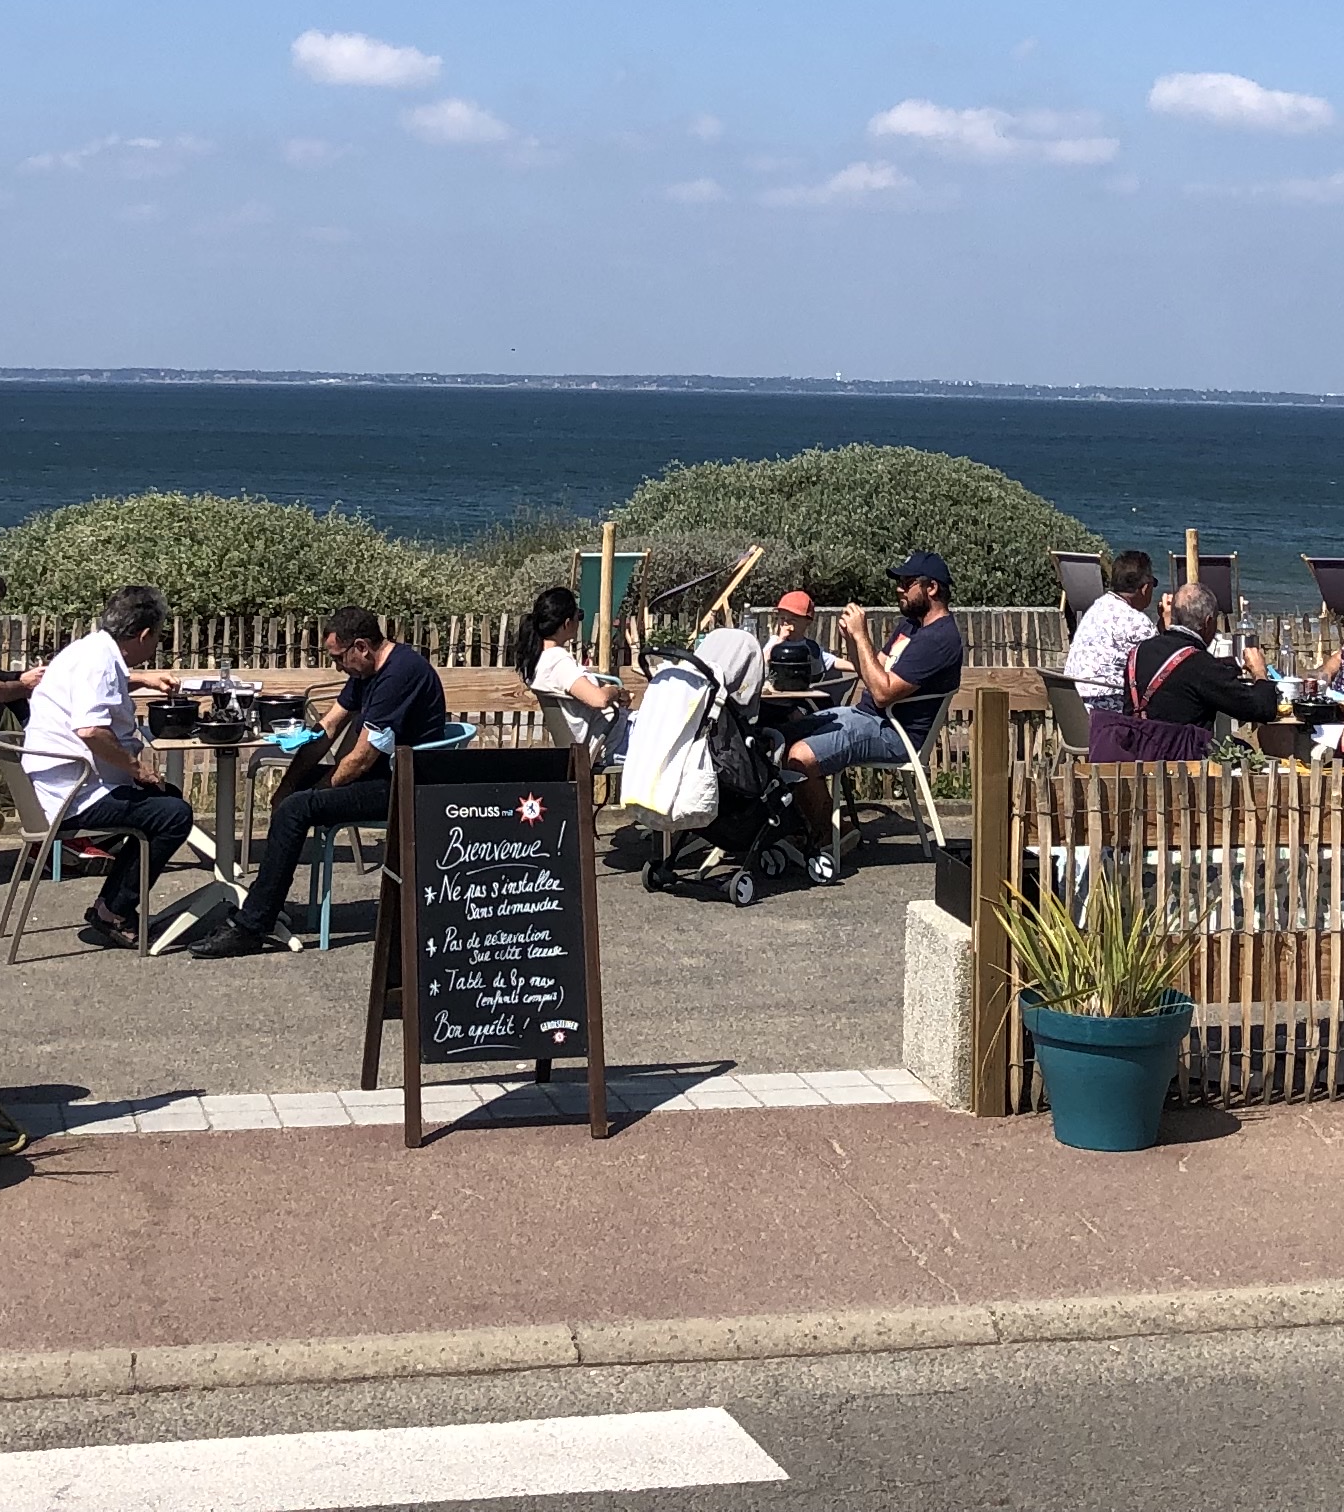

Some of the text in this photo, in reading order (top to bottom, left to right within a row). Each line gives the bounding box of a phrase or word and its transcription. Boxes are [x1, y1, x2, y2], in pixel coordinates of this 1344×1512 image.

[445, 804, 500, 818] Genuss
[436, 826, 550, 869] Bienvenue
[439, 872, 461, 903] Ne
[463, 883, 486, 914] pas
[443, 924, 552, 953] Pas de réservation
[494, 946, 522, 960] cette
[445, 968, 486, 991] Table
[492, 971, 506, 988] de
[529, 976, 555, 988] max
[434, 1010, 464, 1043] Bon
[468, 1013, 514, 1044] appétit
